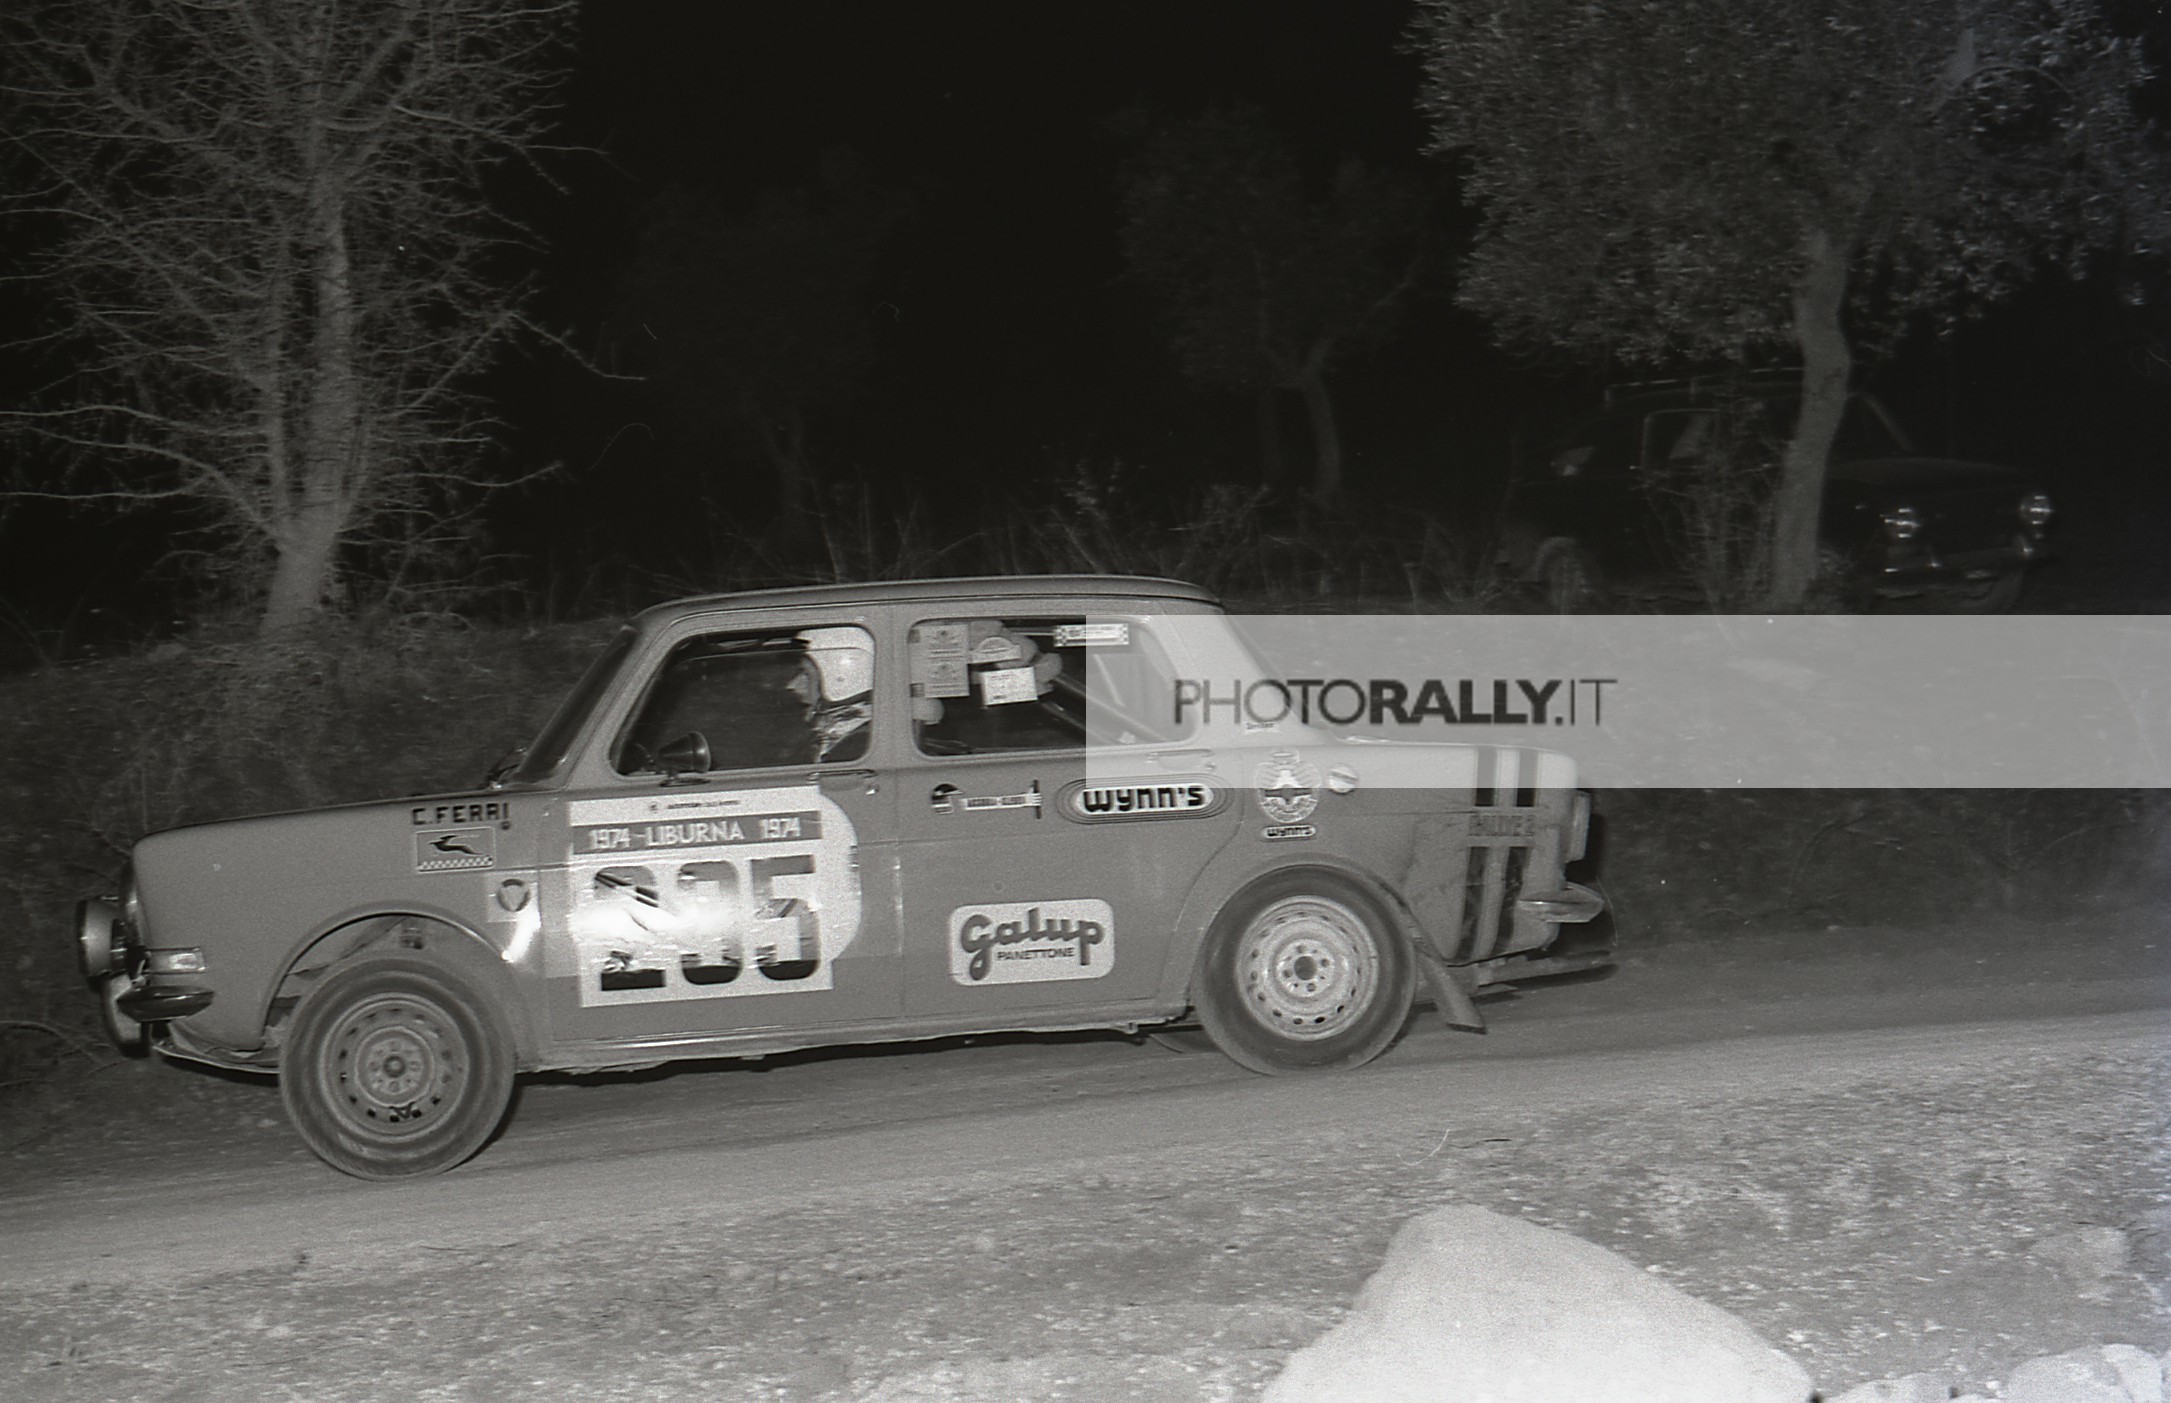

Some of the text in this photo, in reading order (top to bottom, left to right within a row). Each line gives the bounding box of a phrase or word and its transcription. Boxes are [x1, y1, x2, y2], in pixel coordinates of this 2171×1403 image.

[589, 817, 800, 849] 1974 LIBURNA 1974
[997, 947, 1075, 960] PANETTONE
